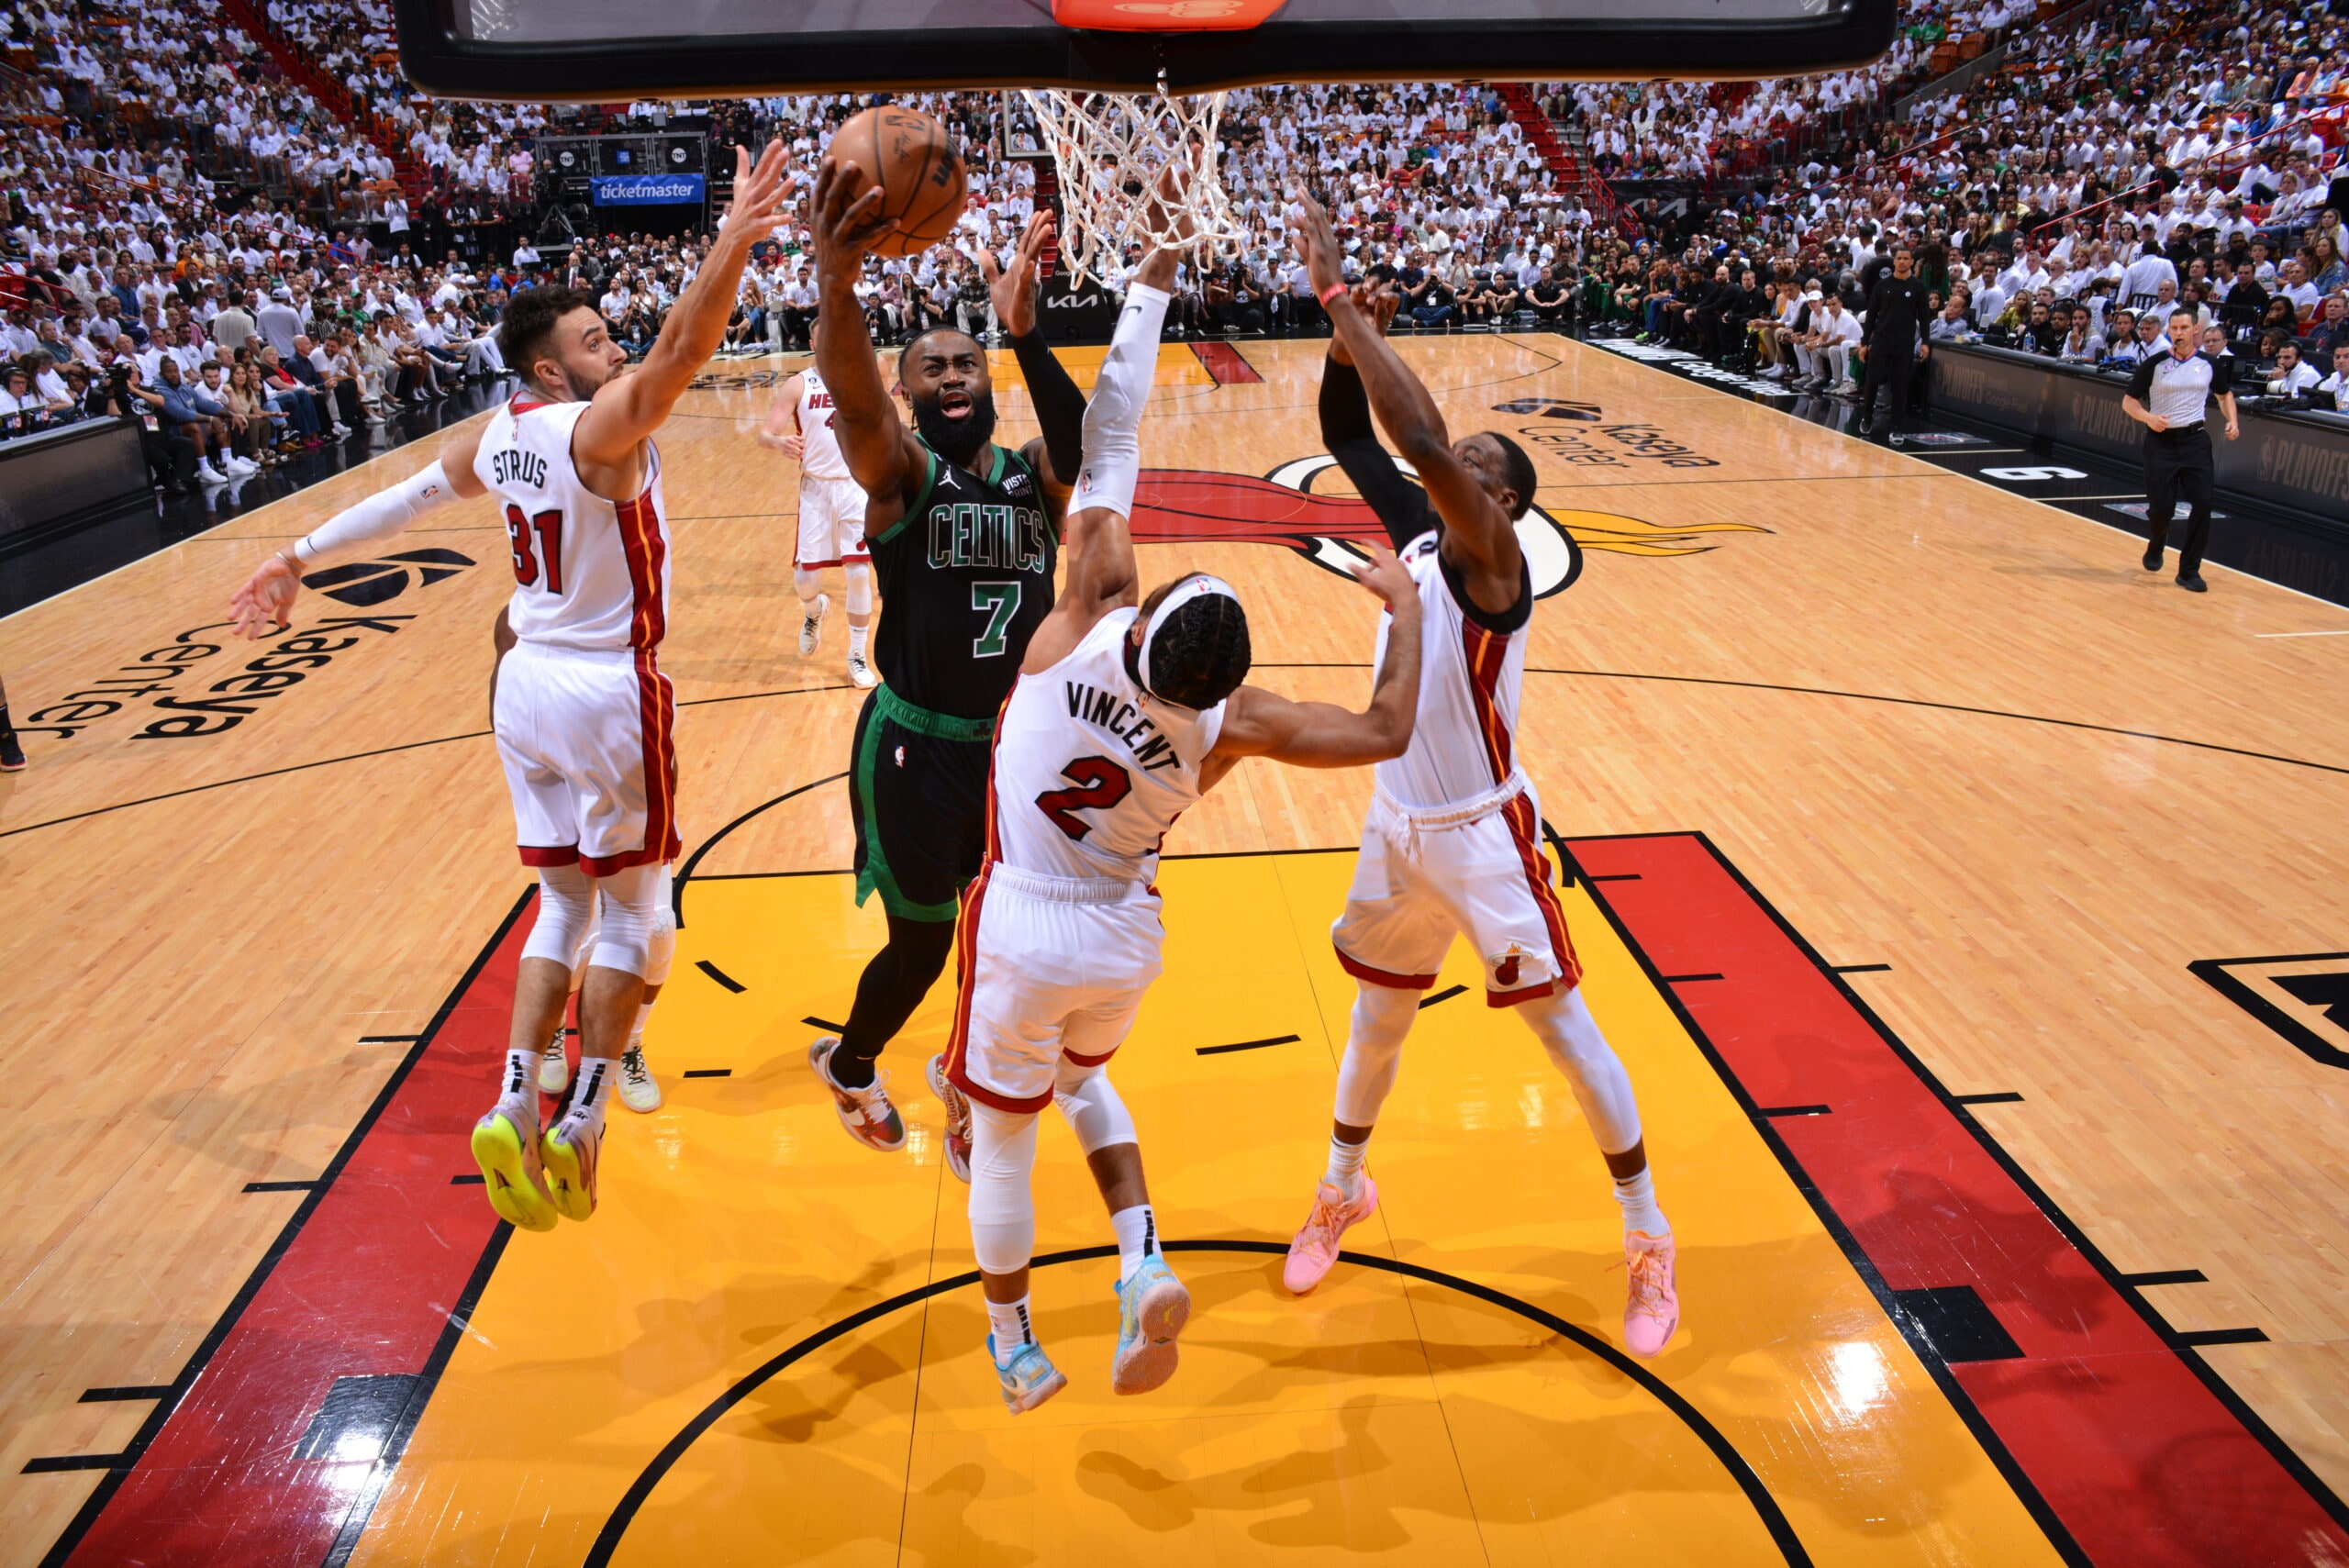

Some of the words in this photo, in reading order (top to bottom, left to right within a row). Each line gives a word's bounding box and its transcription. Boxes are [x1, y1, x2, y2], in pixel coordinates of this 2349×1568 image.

[561, 155, 574, 163] TNT
[673, 151, 686, 160] TNT
[600, 183, 694, 198] ticketmaster
[1047, 295, 1097, 308] KIA
[808, 393, 834, 410] HE
[1518, 426, 1631, 468] Center
[1592, 423, 1720, 468] Kaseya
[493, 450, 548, 489] STRUS
[1002, 473, 1030, 491] VISTA
[1008, 484, 1033, 498] PRINT
[507, 503, 562, 595] 31
[927, 503, 1045, 573] CELTICS
[971, 581, 1021, 658] 7
[14, 619, 291, 739] Center
[128, 615, 418, 740] Kaseya
[1066, 681, 1181, 772] VINCENT
[1034, 755, 1132, 841] 2
